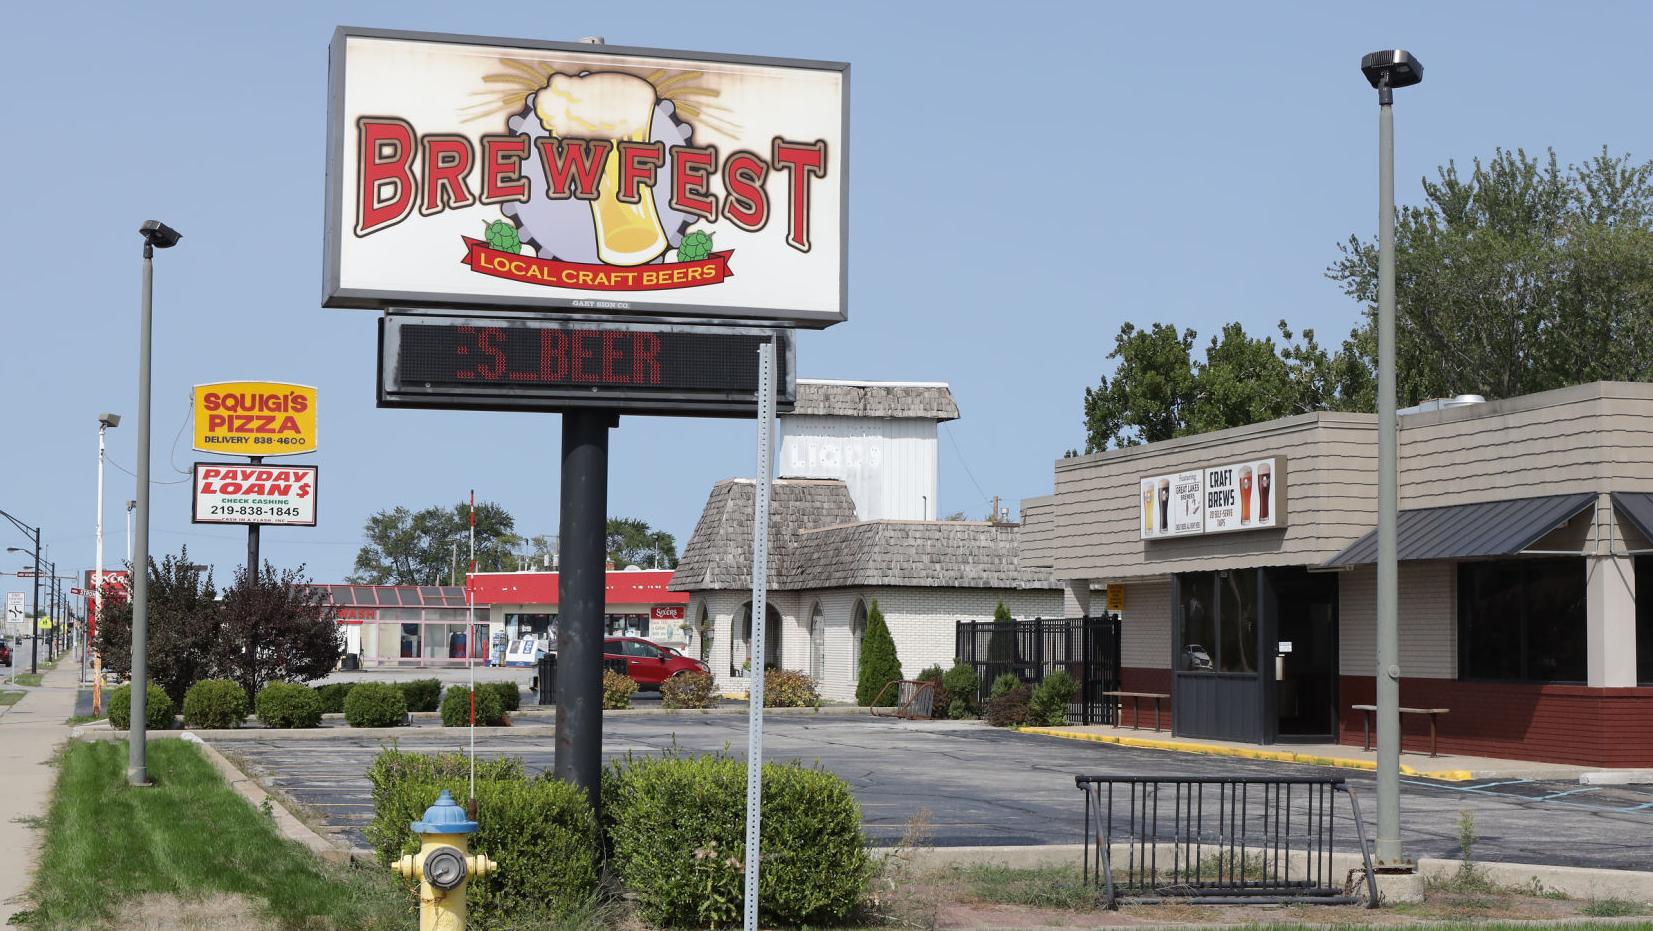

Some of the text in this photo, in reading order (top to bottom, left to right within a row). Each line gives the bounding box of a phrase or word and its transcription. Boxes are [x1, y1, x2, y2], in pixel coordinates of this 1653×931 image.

[354, 116, 828, 253] BREWFEST
[480, 253, 716, 286] LOCAL CRAFT BEERS
[203, 391, 308, 413] SQUIGI'S
[208, 414, 302, 434] PIZZA
[204, 436, 250, 444] DELIVERY
[202, 469, 310, 483] PAYDAY
[1209, 469, 1233, 488] CRAFT
[1175, 484, 1200, 495] GREAT LAKES
[1208, 489, 1235, 508] BREWS
[211, 505, 300, 517] 219-838-1845
